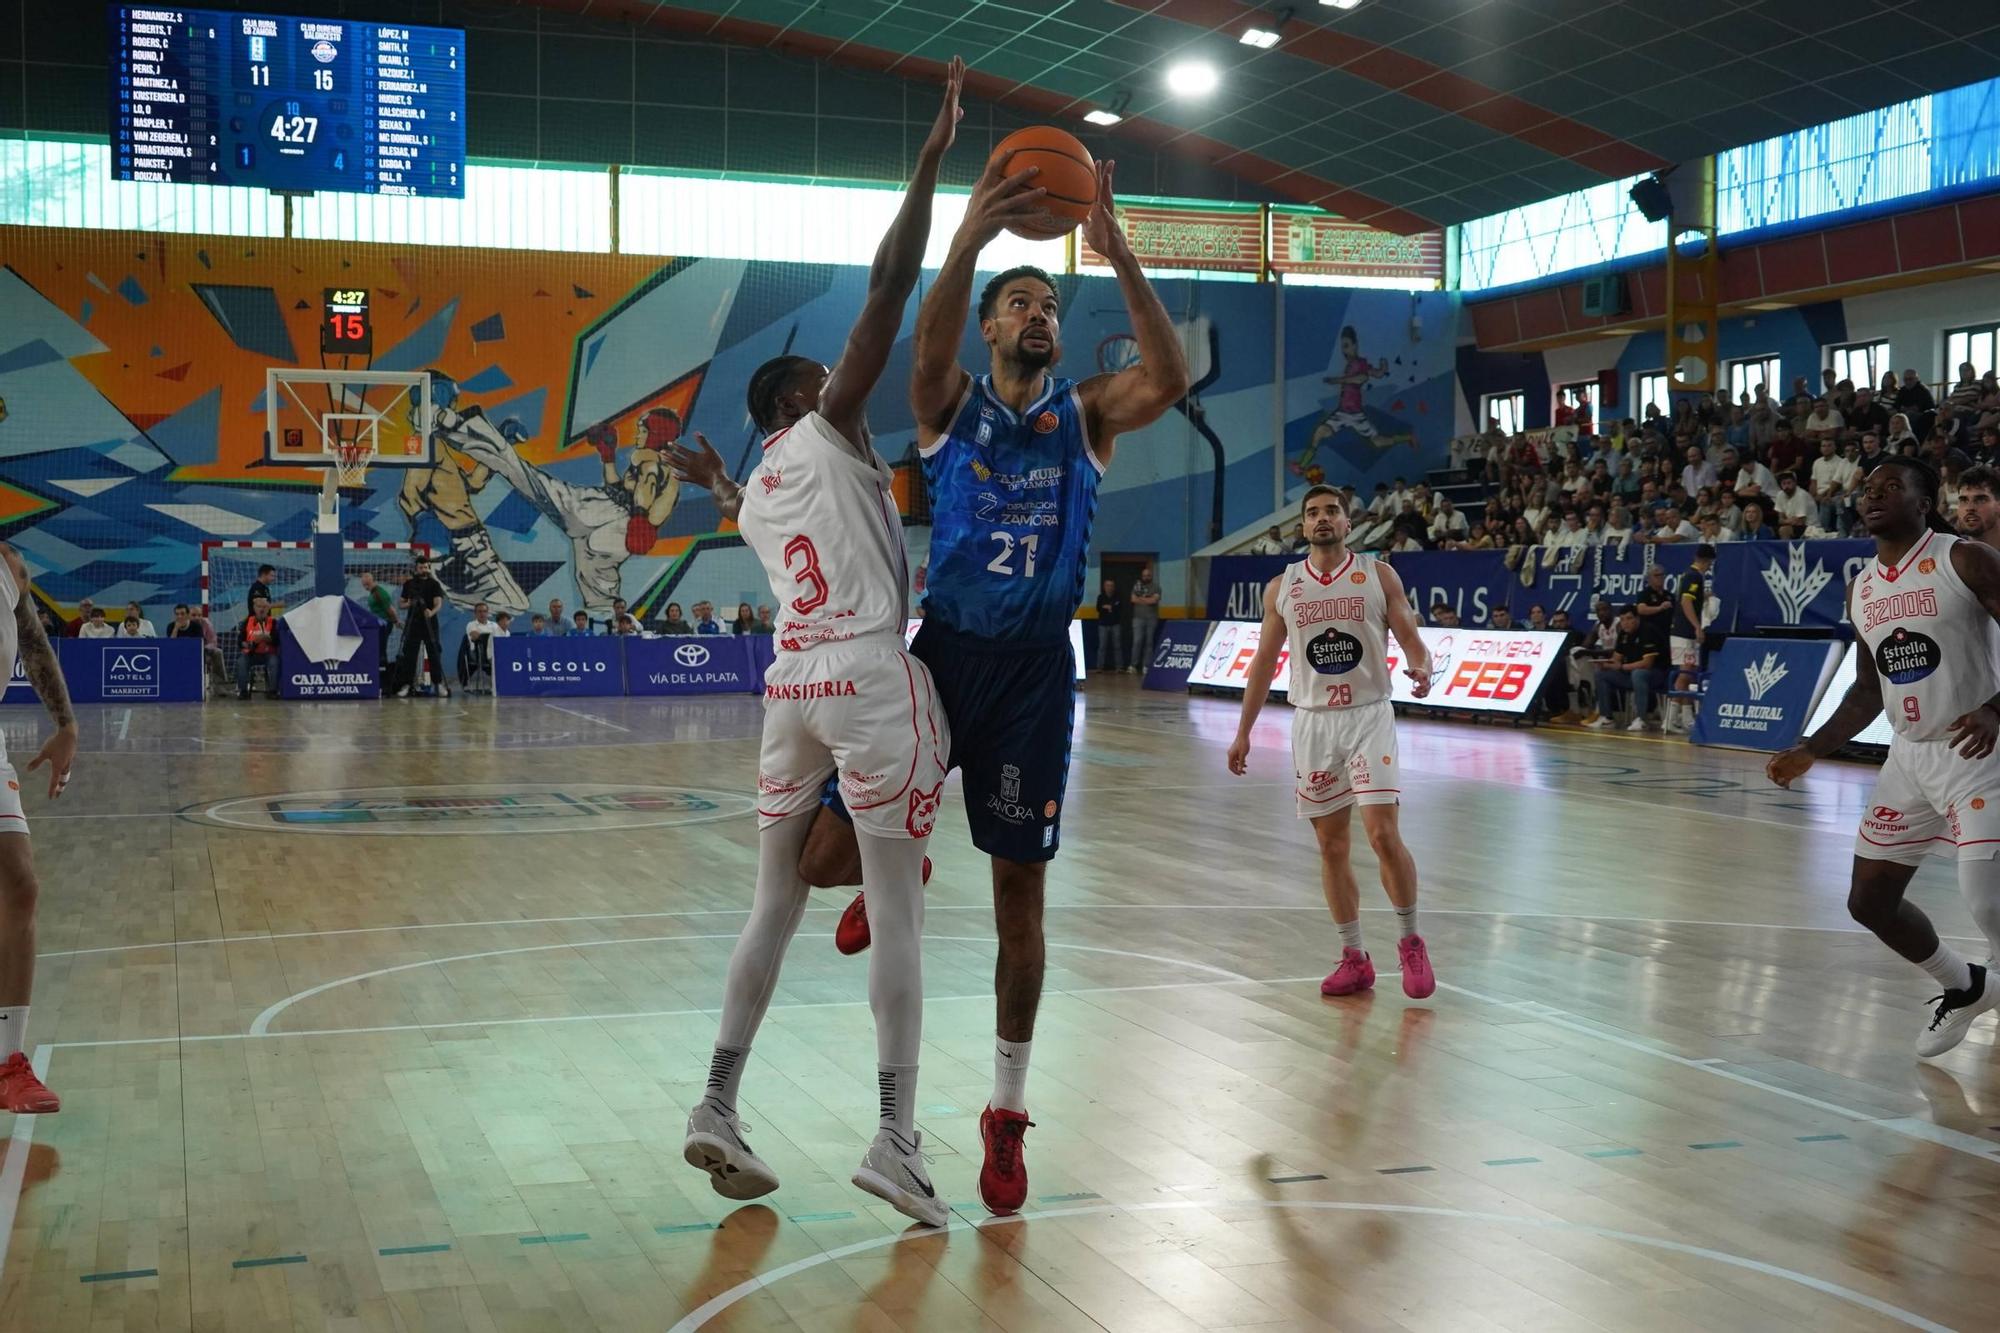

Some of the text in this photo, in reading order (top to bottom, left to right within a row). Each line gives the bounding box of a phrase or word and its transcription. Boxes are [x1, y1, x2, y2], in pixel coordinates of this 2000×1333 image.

[132, 10, 182, 22] HERNANDEZ, S
[132, 23, 166, 35] ROBERTS,
[167, 26, 172, 35] T
[402, 30, 408, 40] M
[132, 37, 162, 48] ROGERS,
[163, 39, 168, 48] C
[378, 42, 456, 56] SMITH, K 2
[133, 50, 158, 62] ROUND,
[133, 64, 155, 75] PERIS,
[404, 57, 409, 66] C
[450, 60, 456, 70] 4
[251, 65, 269, 86] 11
[314, 69, 333, 90] 15
[378, 68, 410, 79] VAZQUEZ,
[133, 77, 170, 89] MARTINEZ,
[172, 80, 177, 89] A
[378, 81, 419, 93] FERNANDEZ,
[420, 84, 427, 93] M
[133, 91, 178, 103] KRISTENSEN,
[407, 96, 412, 105] S
[378, 107, 420, 119] KALSCHEUR,
[450, 112, 456, 121] 2
[168, 120, 173, 129] T
[271, 115, 318, 143] 4:27
[379, 120, 404, 131] SEIXAS,
[120, 131, 129, 139] 21
[134, 131, 148, 141] VAN
[210, 135, 216, 145] 2
[379, 133, 390, 142] MC
[391, 133, 422, 145] DONNELL,
[423, 136, 428, 145] S
[134, 144, 185, 157] THRASTARSON,
[187, 147, 192, 157] S
[242, 146, 249, 166] 1
[379, 146, 410, 158] IGLESIAS,
[411, 148, 418, 157] M
[134, 158, 167, 170] PAUKSTE,
[210, 162, 216, 172] 4
[334, 153, 344, 171] 4
[379, 159, 404, 170] LISBOA,
[405, 160, 411, 170] R
[134, 171, 164, 182] BOUZAN,
[166, 173, 171, 182] A
[396, 173, 402, 182] R
[450, 176, 456, 186] 2
[411, 187, 416, 196] C
[1136, 221, 1241, 241] AYUNTAMIENTO
[1134, 236, 1240, 258] DE ZAMORA
[1321, 242, 1423, 264] DE ZAMORA
[332, 290, 365, 304] 4:27
[330, 314, 364, 340] 15
[1008, 478, 1060, 492] DE ZAMORA
[1001, 514, 1059, 526] ZAMORA
[987, 531, 1039, 577] 21
[784, 534, 829, 616] 3
[1226, 582, 1488, 623] ALIM ADIS
[1294, 596, 1365, 628] 32005
[1863, 588, 1937, 633] 32005
[1313, 641, 1354, 654] Estrella
[1468, 640, 1542, 658] PRIMERA
[1884, 641, 1927, 659] Estrella
[111, 654, 151, 672] AC
[1315, 652, 1353, 665] Galicia
[1888, 655, 1927, 672] Galicia
[512, 662, 606, 672] DISCOLO
[292, 674, 372, 685] CAJA RURAL
[650, 672, 739, 684] VÍA DE LA PLATA
[1444, 660, 1532, 700] FEB
[301, 686, 359, 694] DE ZAMORA
[767, 681, 856, 700] RANSITERIA
[1326, 684, 1352, 706] 28
[1718, 704, 1783, 720] CAJA RURAL
[1904, 696, 1920, 722] 9
[1719, 718, 1768, 731] DE ZAMORA
[1306, 775, 1339, 792] HYUNDAI
[987, 793, 1035, 820] ZAMORA
[1864, 820, 1909, 831] HYUNDAI
